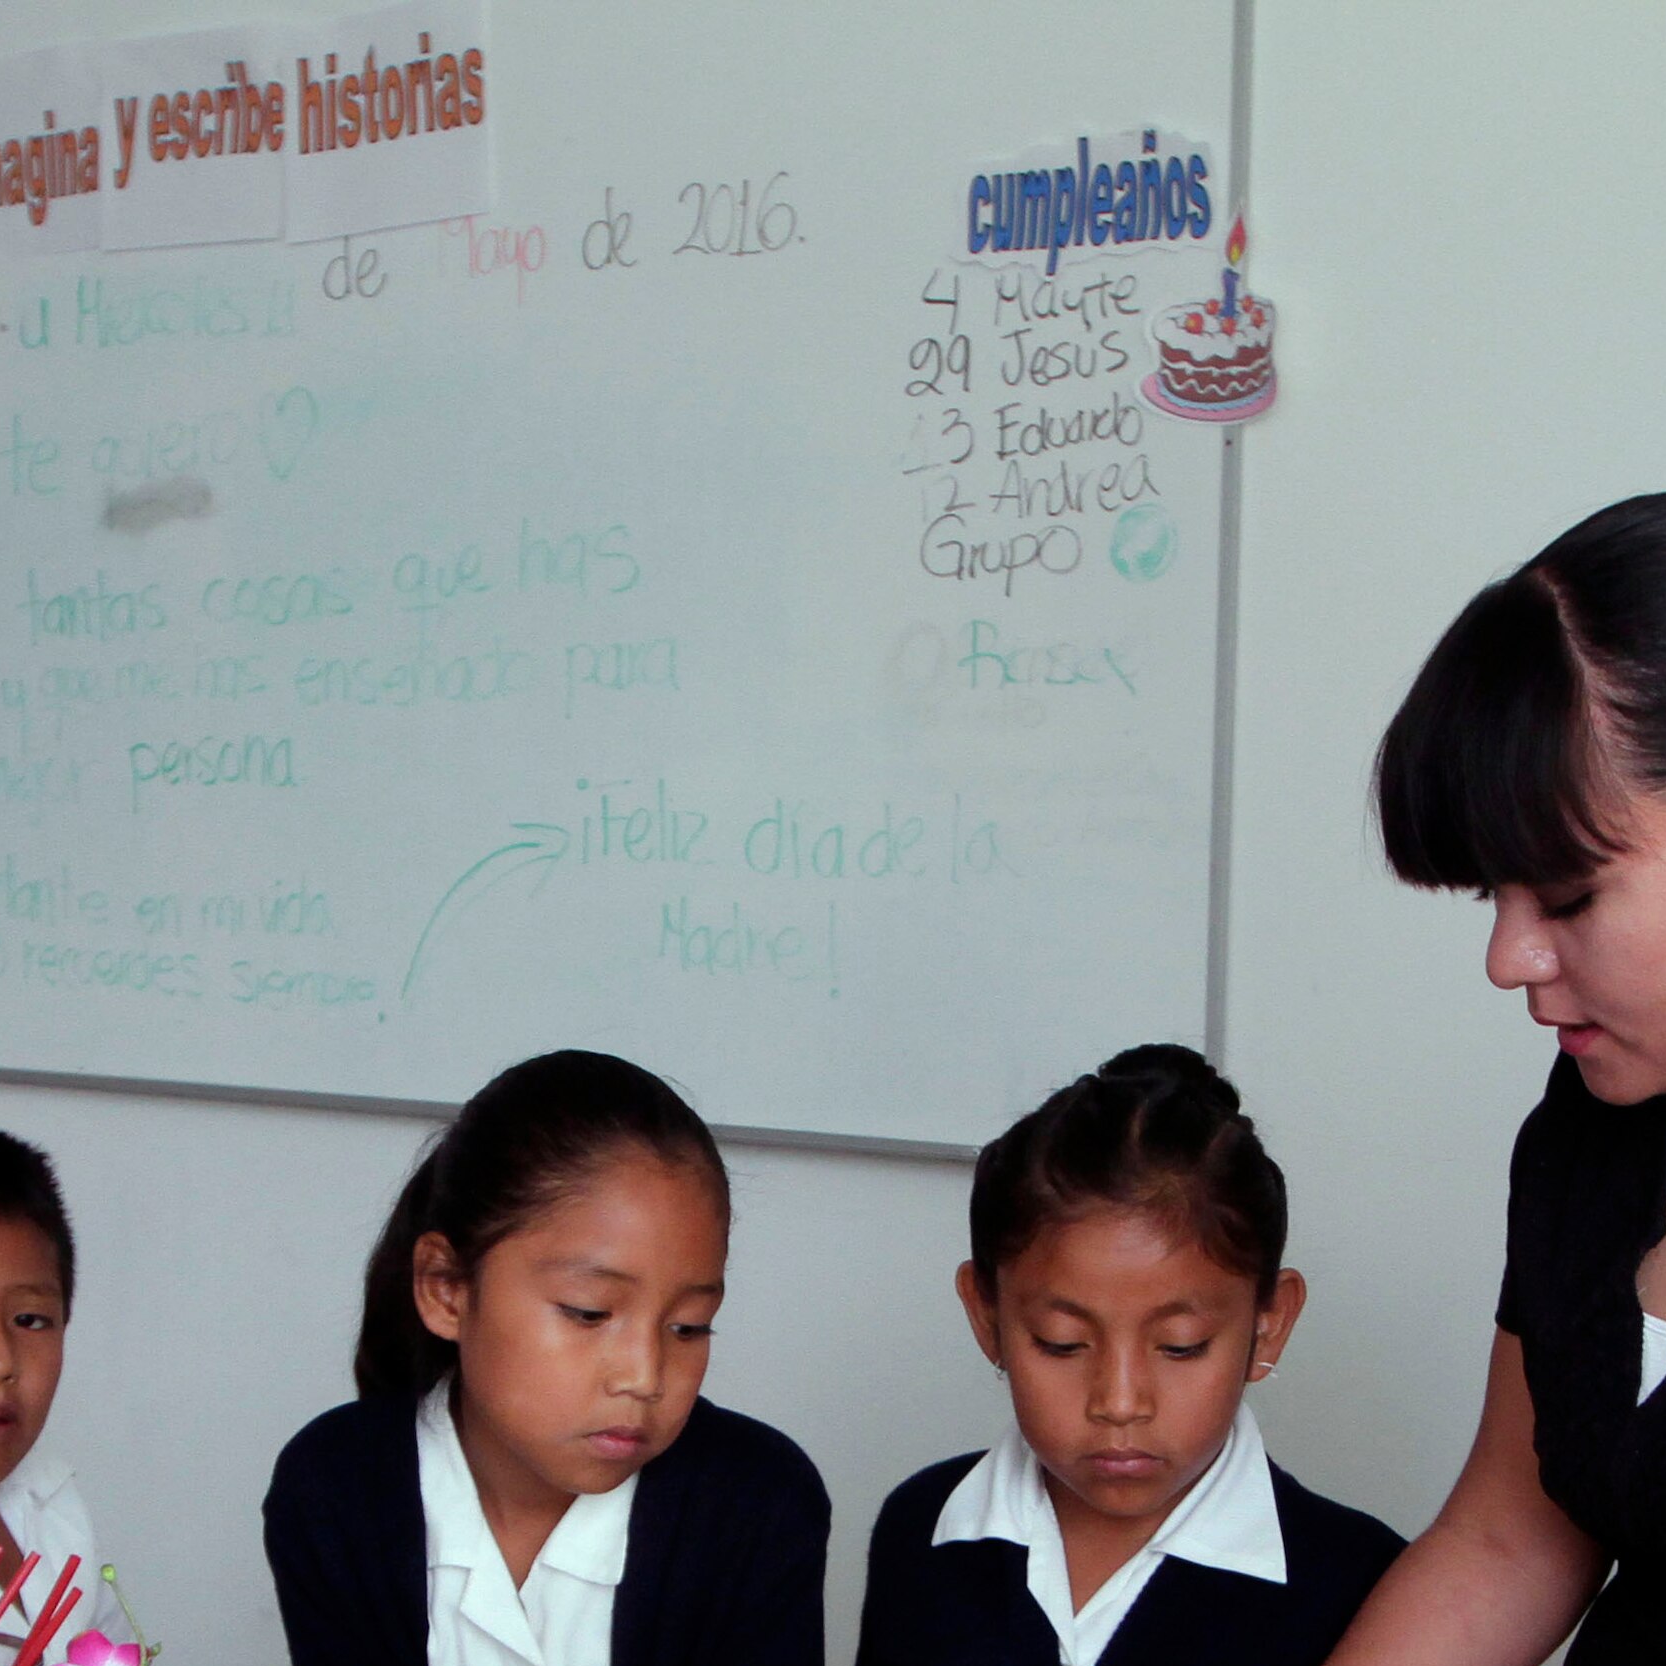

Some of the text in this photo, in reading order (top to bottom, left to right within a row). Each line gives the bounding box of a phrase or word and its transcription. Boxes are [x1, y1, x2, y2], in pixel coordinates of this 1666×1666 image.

[113, 97, 139, 190] y
[147, 60, 286, 162] escribe
[296, 31, 486, 155] historias
[322, 235, 389, 301] de
[582, 186, 639, 273] de
[672, 170, 808, 258] 2016.
[967, 129, 1211, 277] cumpleaños
[921, 267, 1143, 336] 4 Mayte
[904, 333, 972, 398] 29
[987, 452, 1162, 519] Andrea
[919, 510, 1084, 598] Grupo
